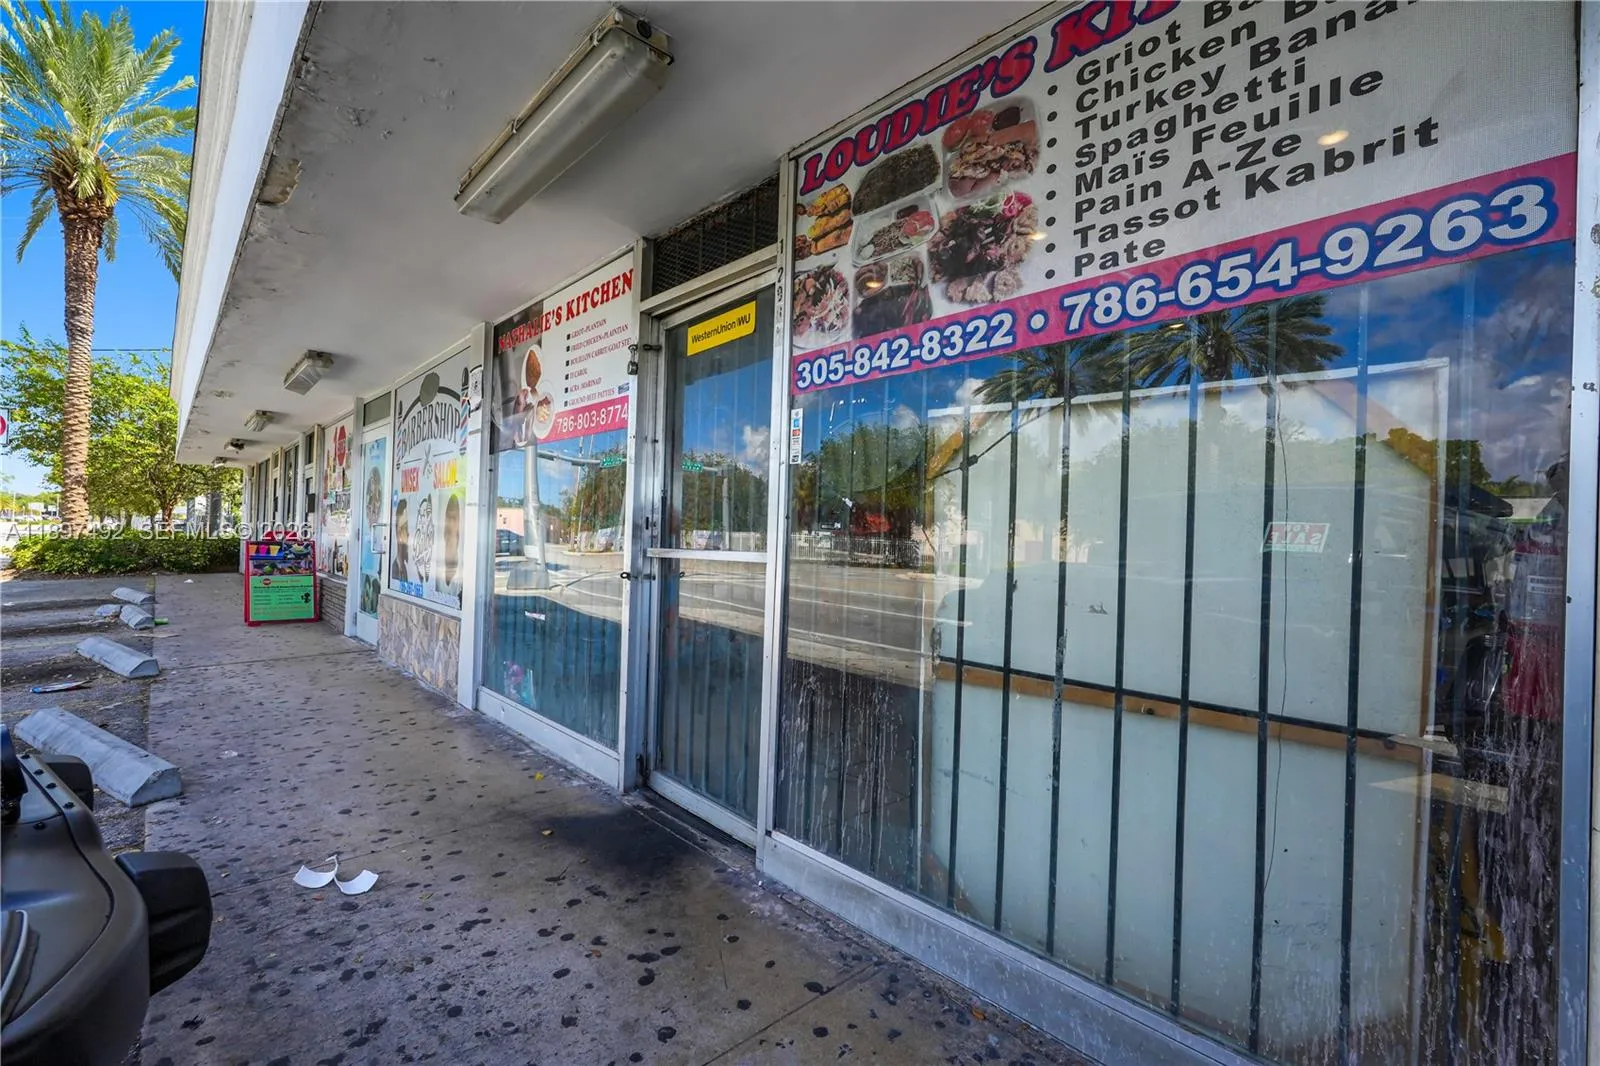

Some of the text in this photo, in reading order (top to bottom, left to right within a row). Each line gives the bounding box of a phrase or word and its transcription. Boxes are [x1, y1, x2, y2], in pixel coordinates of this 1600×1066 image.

[1074, 0, 1419, 140] Turkey Bana
[1076, 19, 1182, 86] Griot
[1076, 20, 1257, 113] Chicken
[798, 36, 1039, 197] LOUDIE'S
[1074, 56, 1306, 169] Spaghetti
[1075, 70, 1384, 197] Maïs Feuille
[1073, 116, 1439, 249] Tassot Kabrit
[1075, 133, 1302, 224] Pain A-Ze
[565, 267, 634, 321] KITCHEN
[796, 181, 1552, 390] 305-842-8322 786-654-9263
[1074, 238, 1166, 278] Pate
[691, 320, 736, 345] WesternUnion
[401, 401, 461, 460] BARBERSHOP
[401, 466, 420, 493] UNISEX
